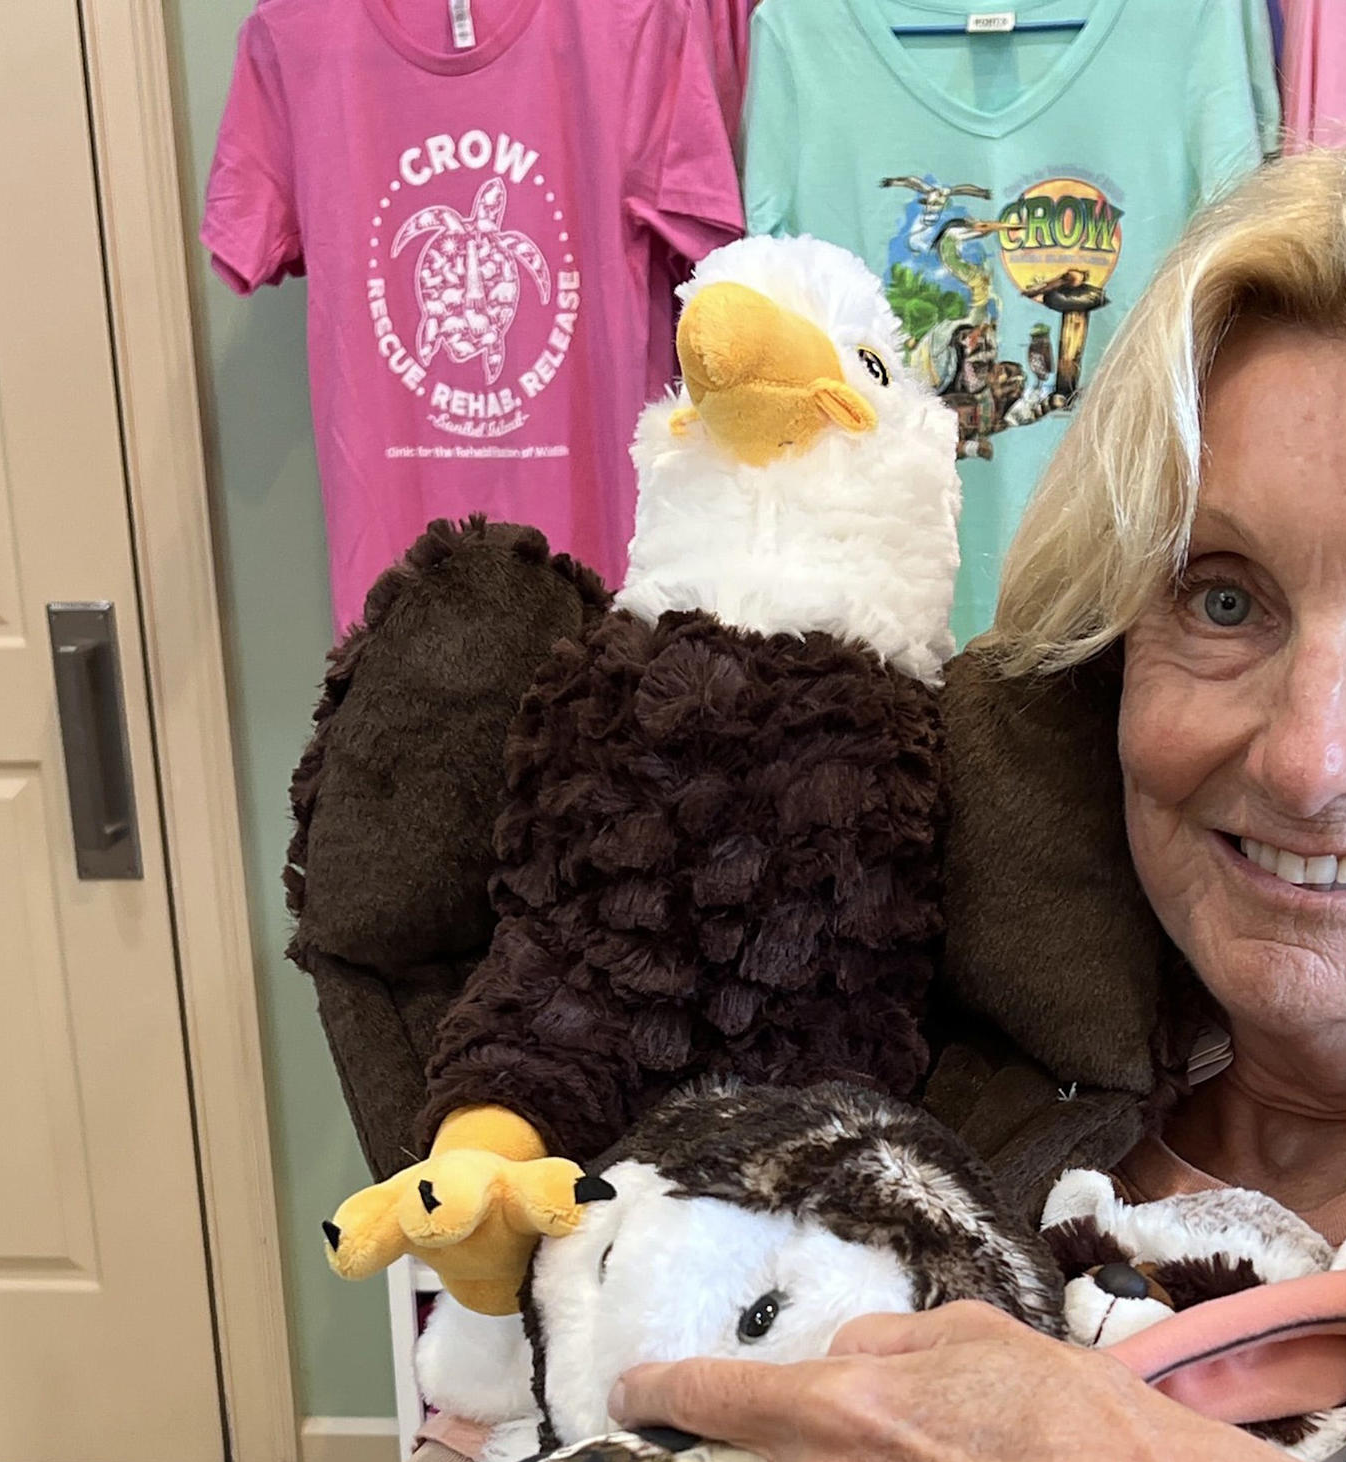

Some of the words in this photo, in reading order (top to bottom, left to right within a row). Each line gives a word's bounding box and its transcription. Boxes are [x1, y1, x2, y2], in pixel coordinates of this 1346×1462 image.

[399, 129, 540, 186] CROW
[999, 195, 1124, 252] CROW
[519, 270, 580, 398] RELEASE
[431, 382, 522, 418] REHAB.
